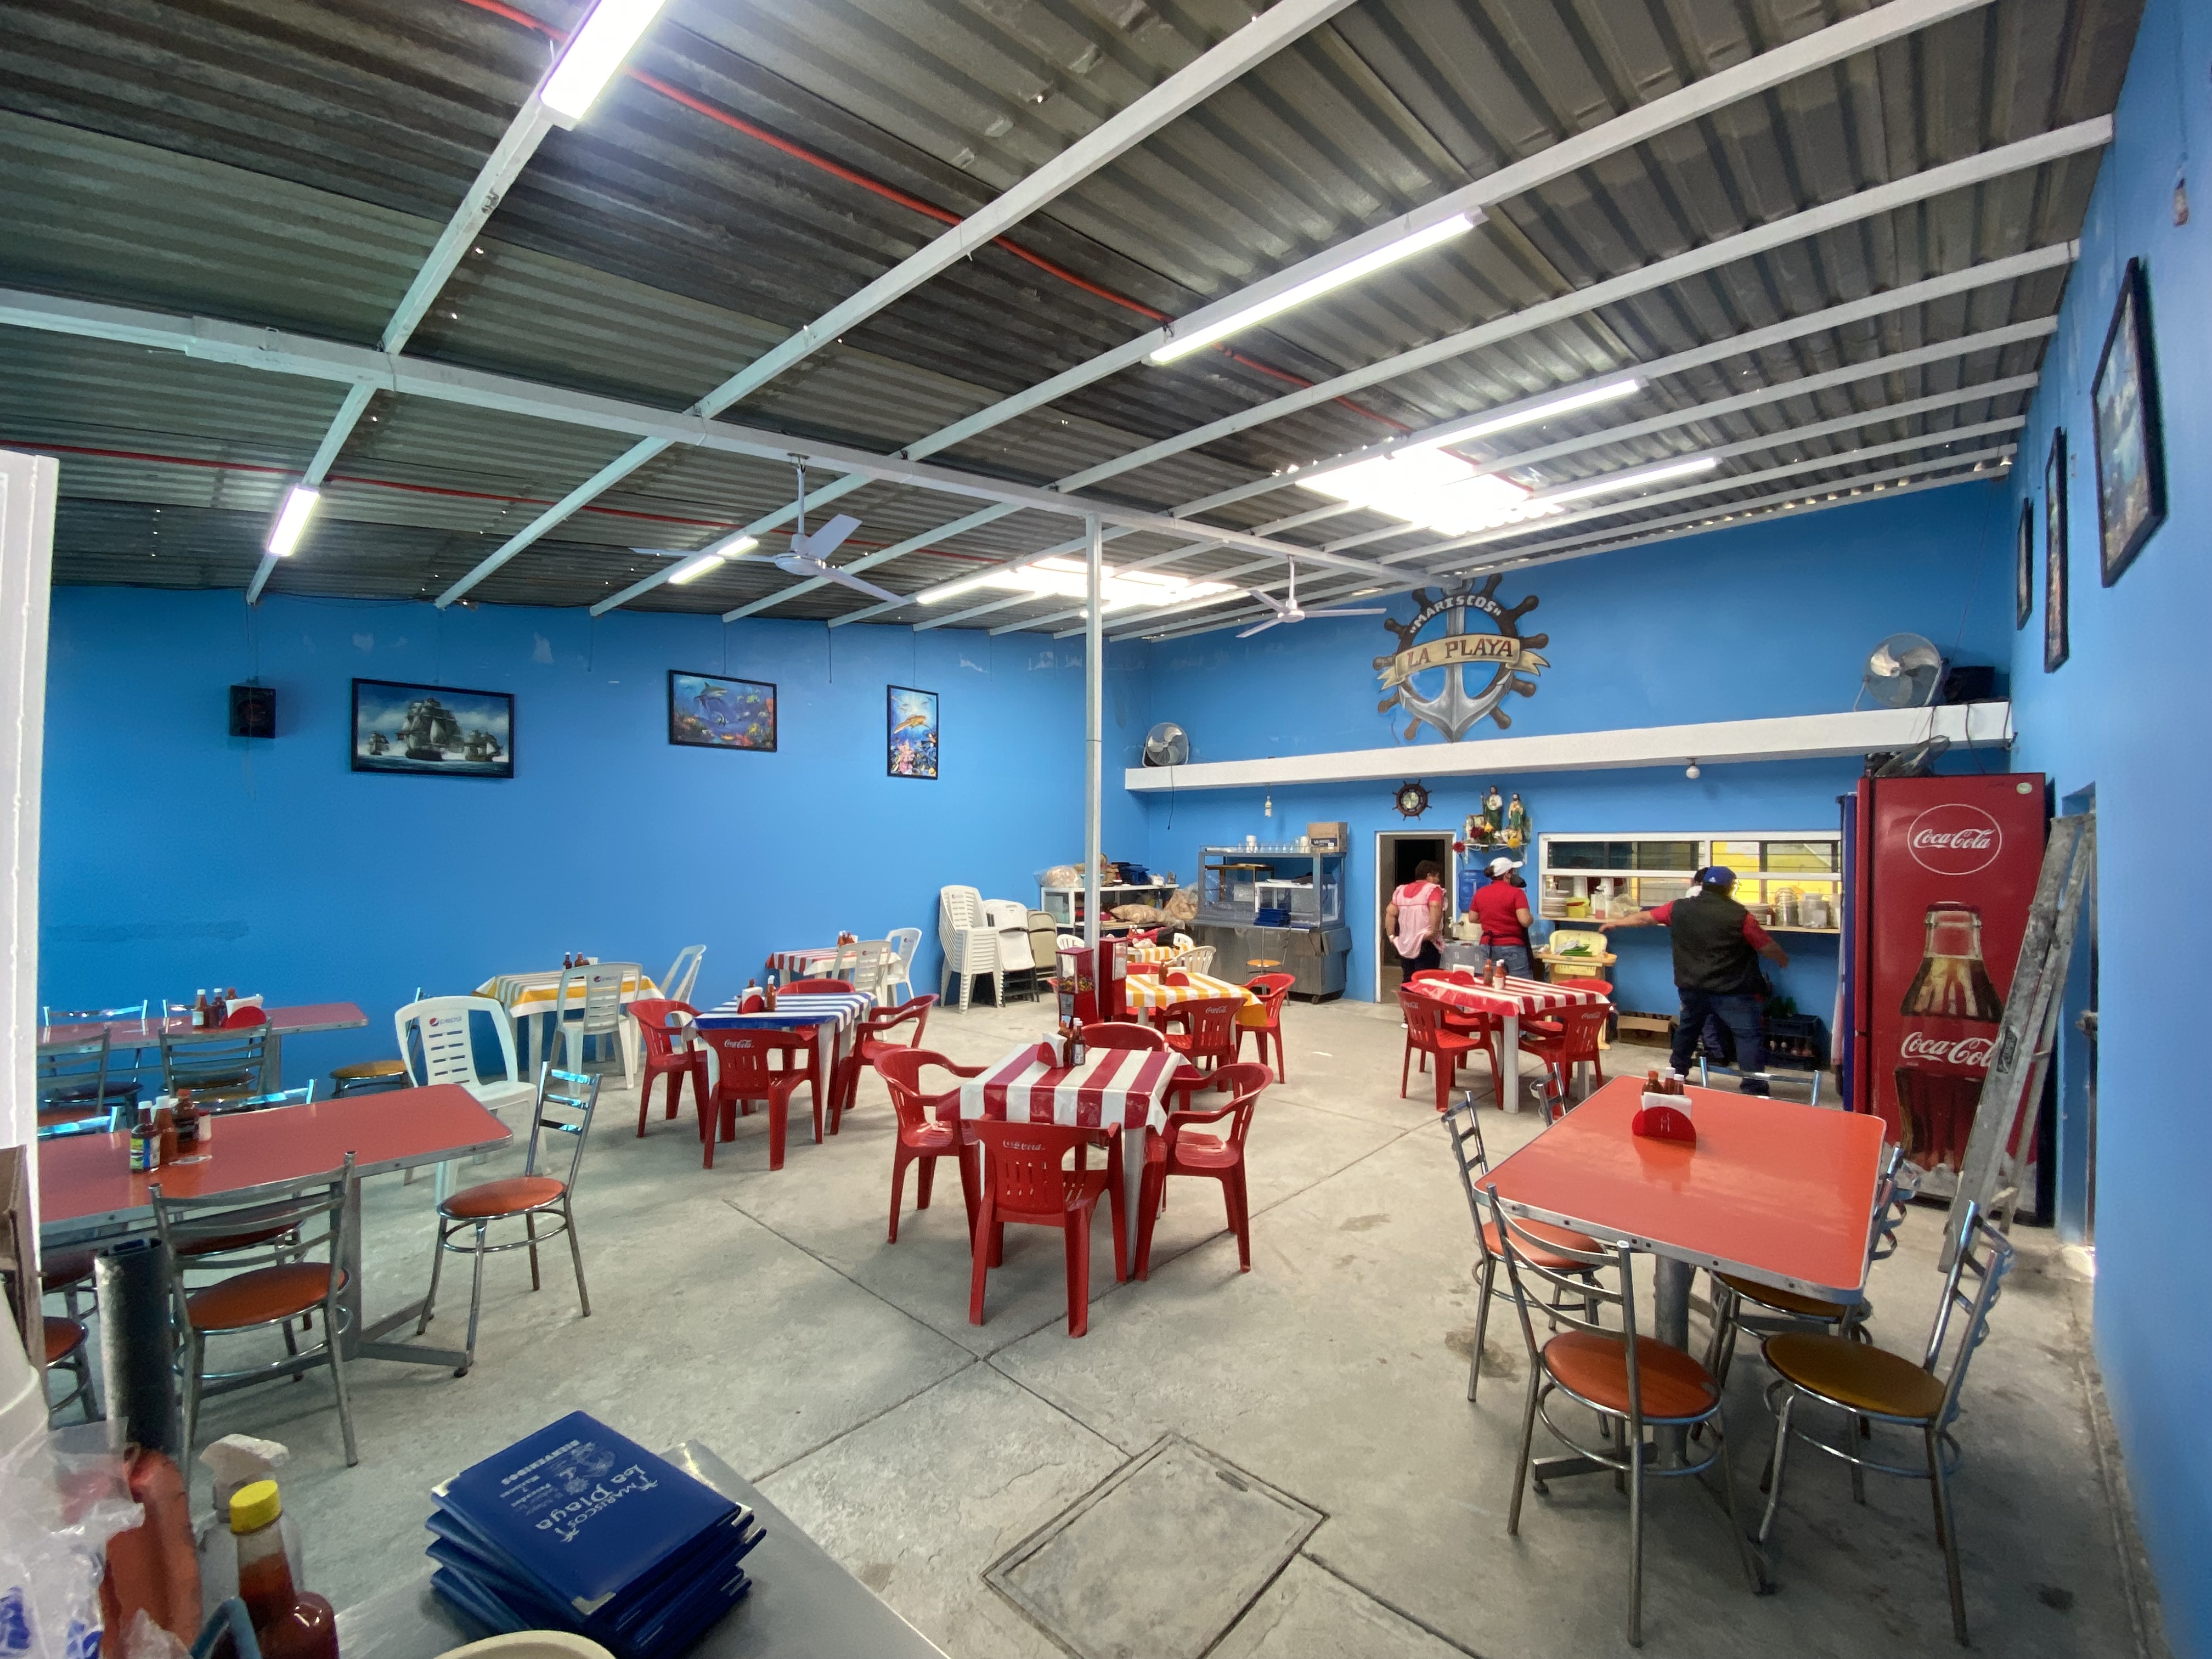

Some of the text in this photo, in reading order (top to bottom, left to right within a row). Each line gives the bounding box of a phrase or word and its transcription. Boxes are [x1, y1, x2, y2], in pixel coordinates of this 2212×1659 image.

[1407, 639, 1513, 667] LA PLAYA
[1914, 829, 1995, 849] Coca-Cola
[724, 1039, 752, 1048] Coca-Cola
[1901, 1031, 1997, 1067] Coca-Col
[610, 1464, 648, 1483] La
[535, 1483, 613, 1530] Playa
[567, 1483, 636, 1527] MARISCOS
